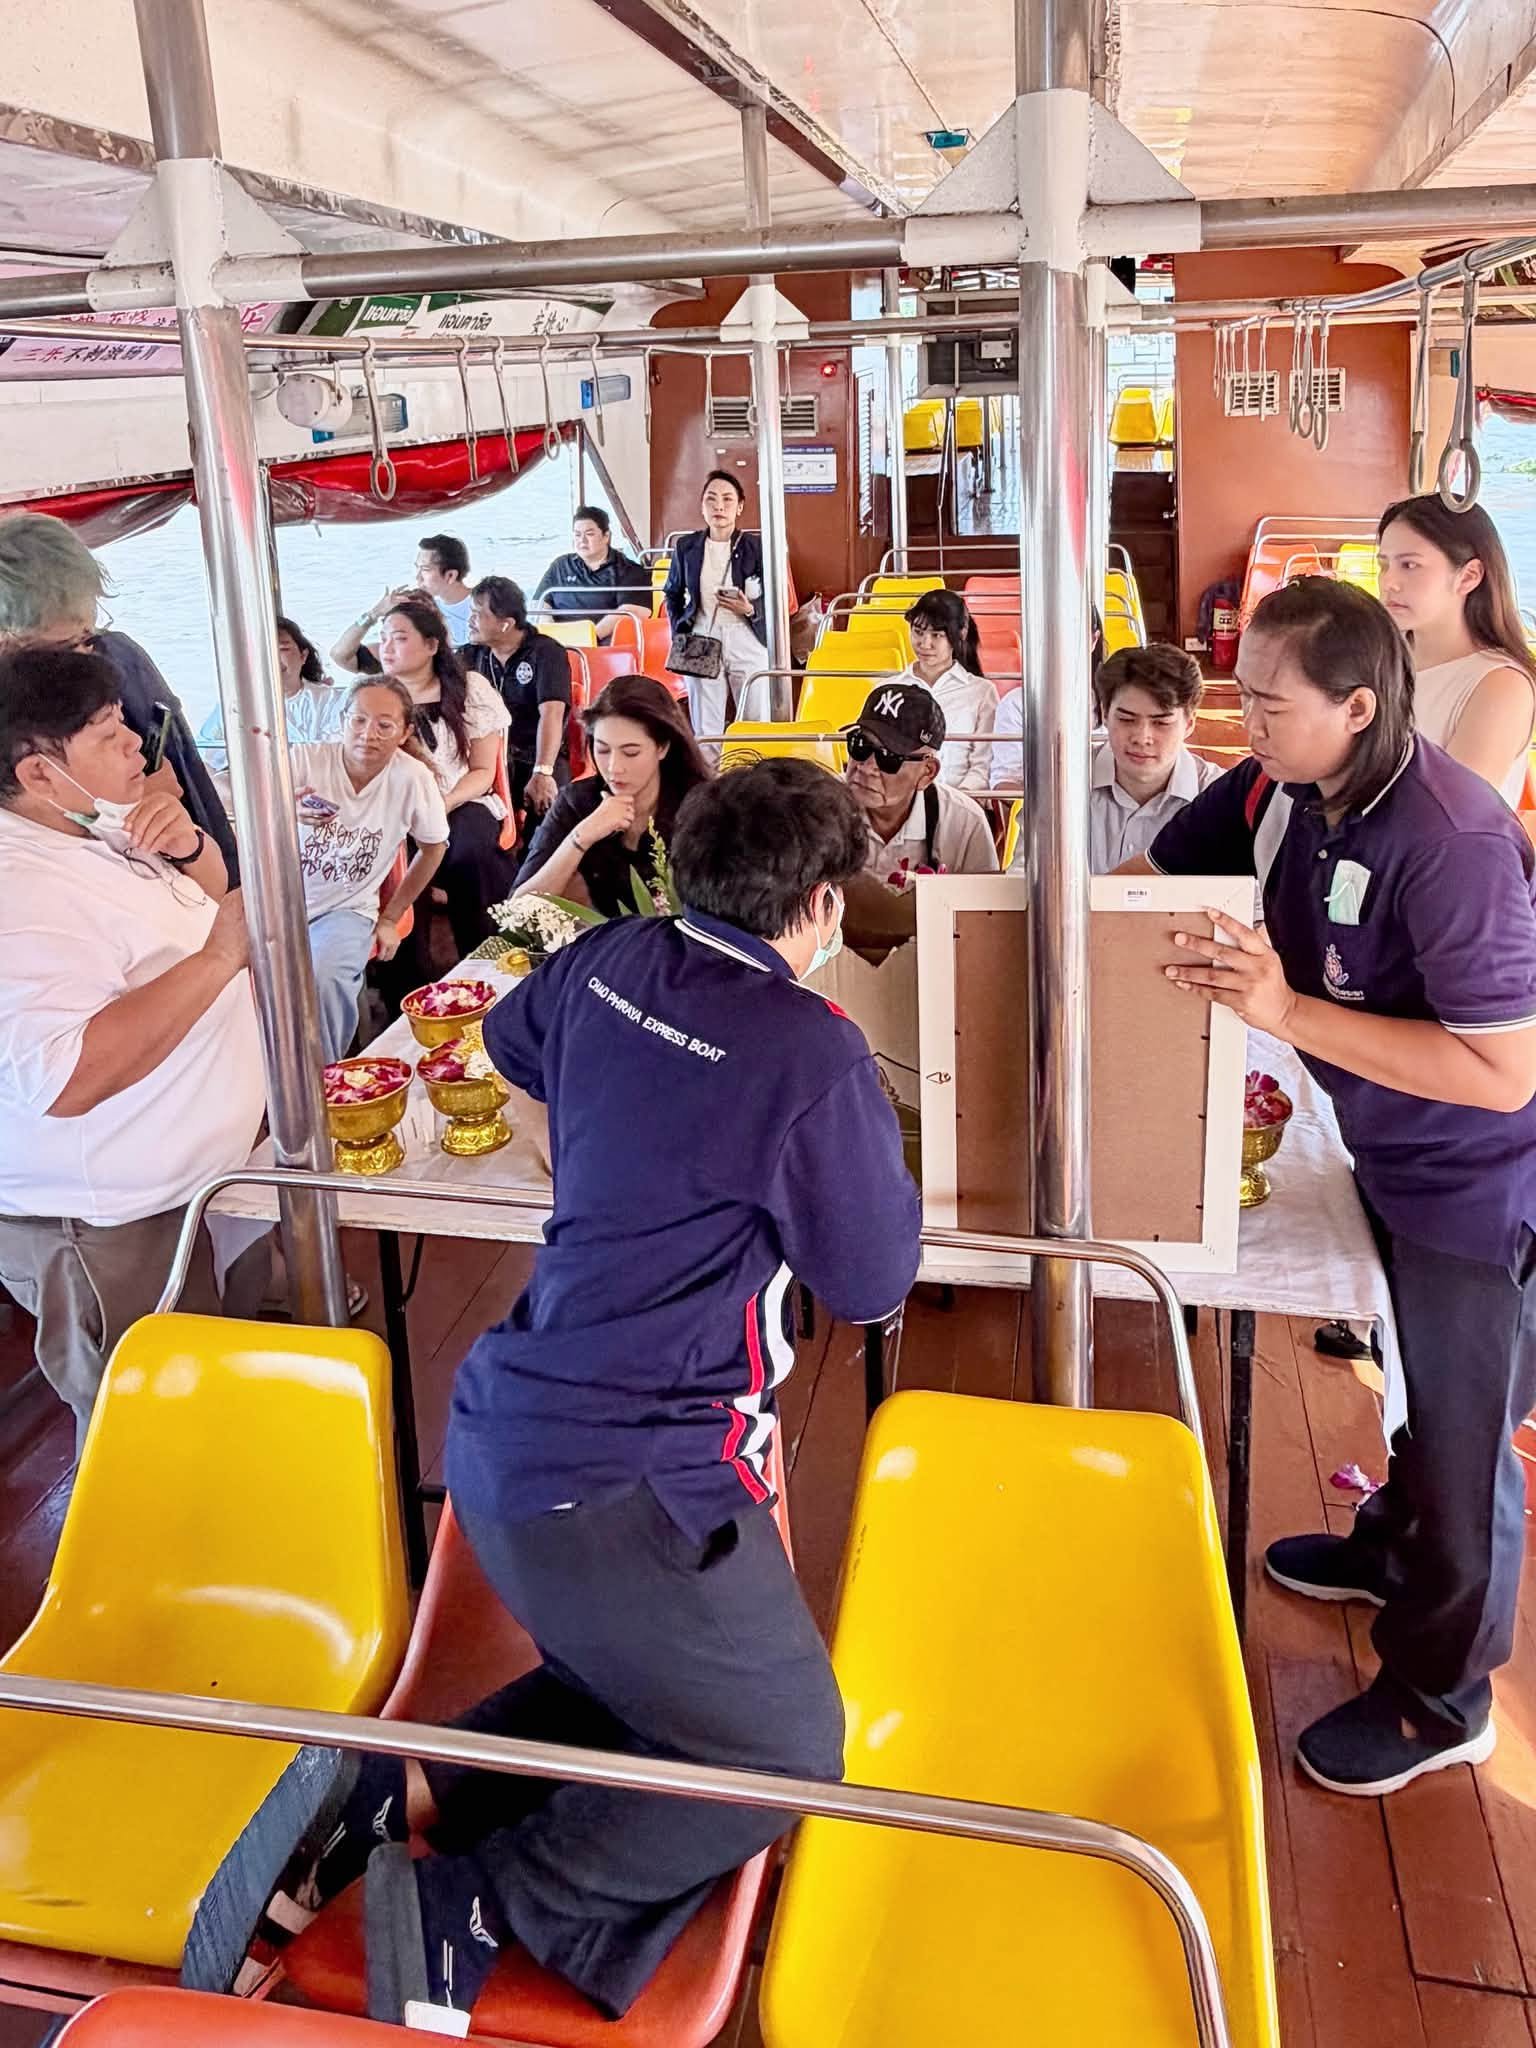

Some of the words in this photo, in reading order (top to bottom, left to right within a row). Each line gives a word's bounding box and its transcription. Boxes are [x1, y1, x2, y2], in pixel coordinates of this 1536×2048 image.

[873, 689, 905, 719] NY
[605, 991, 643, 1024] PHRAYA
[642, 1016, 689, 1047] EXPRESS
[687, 1038, 727, 1062] BOAT
